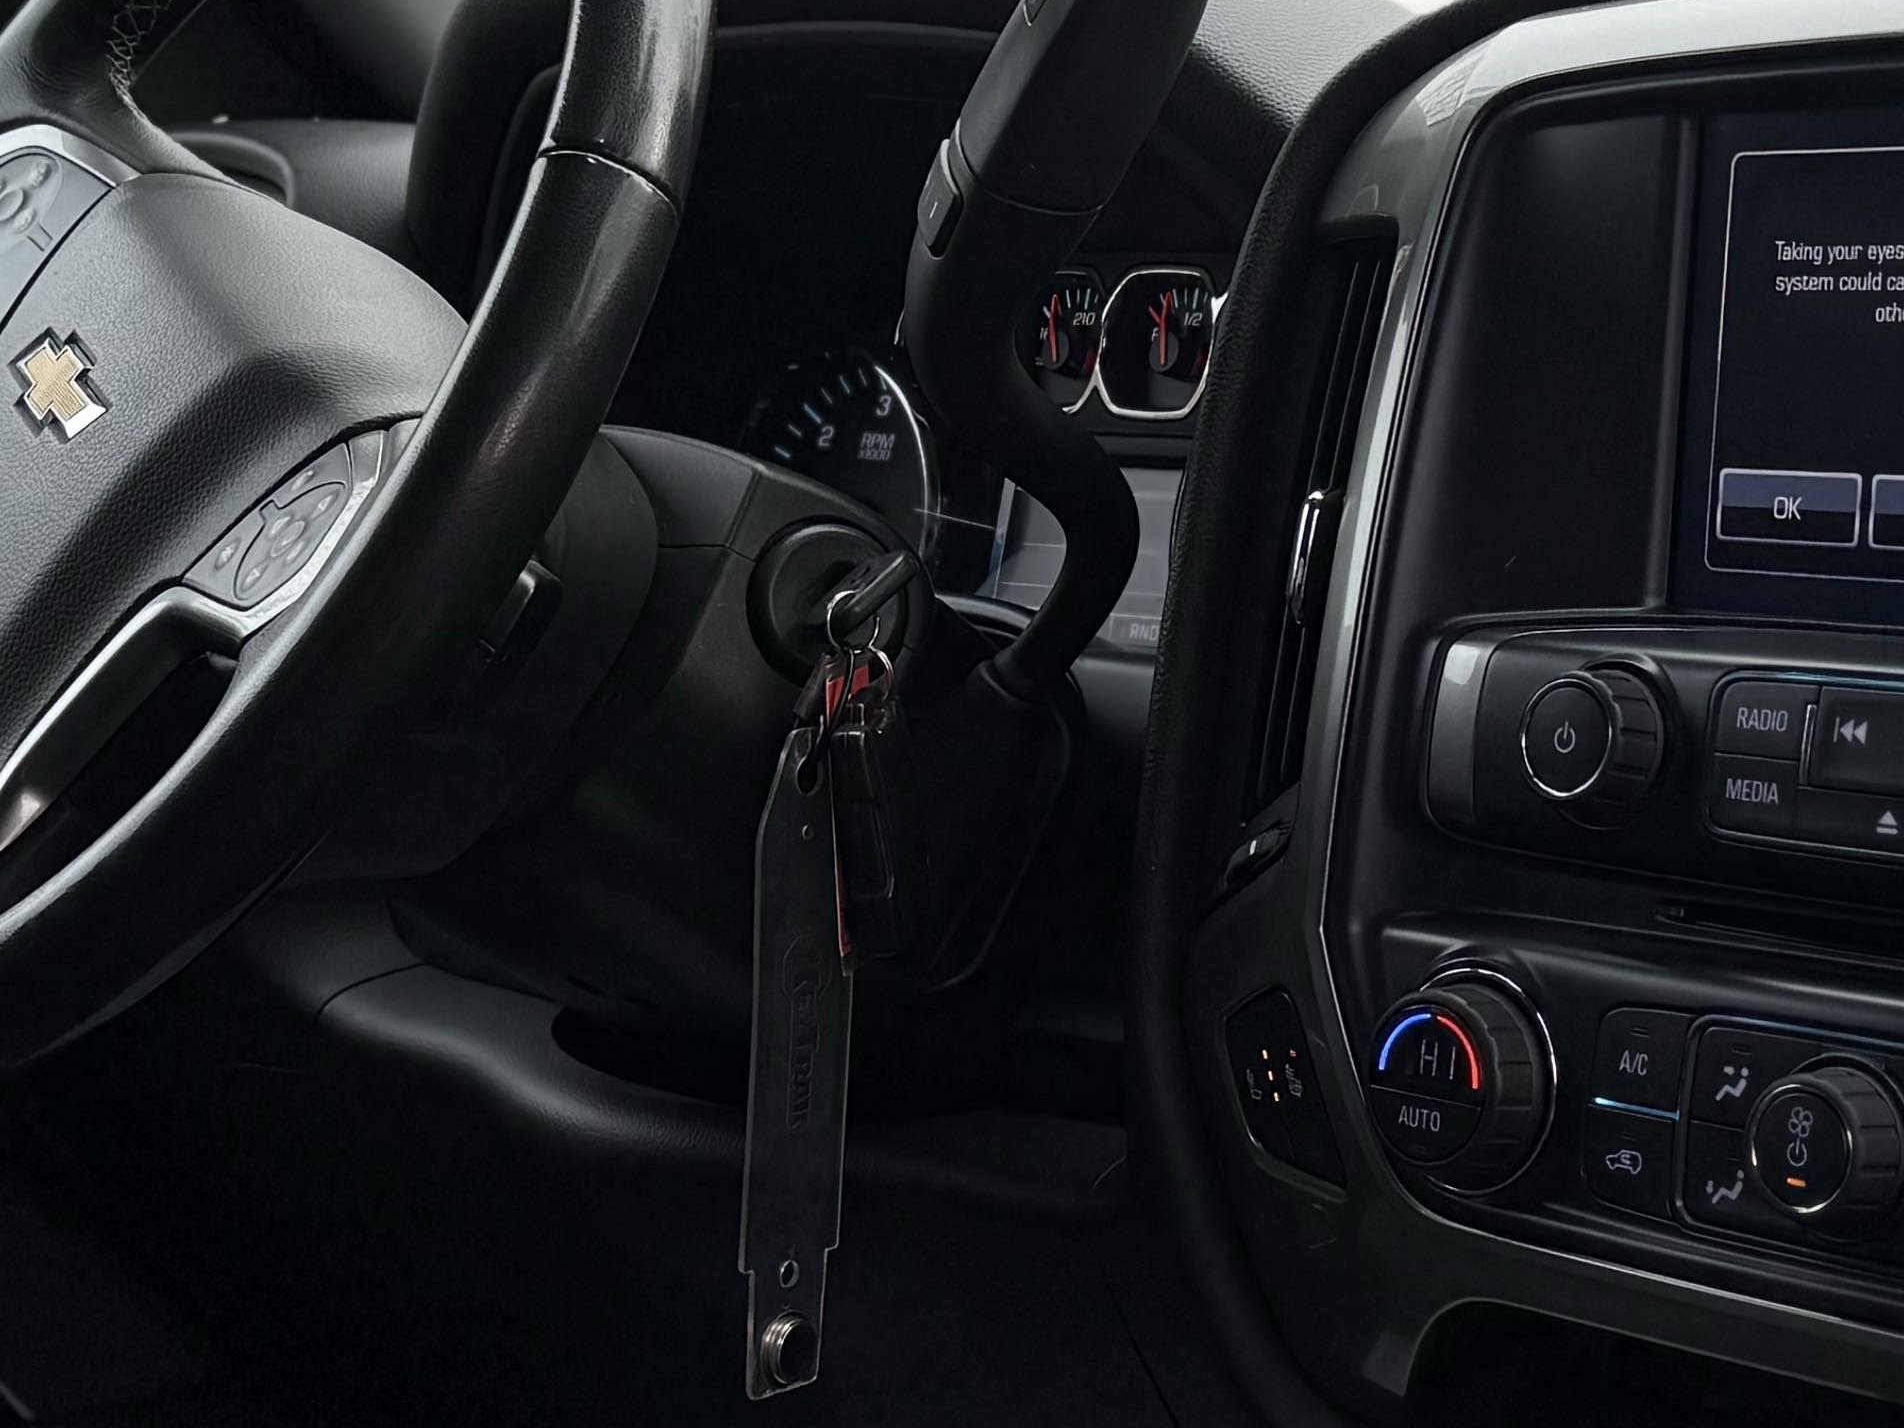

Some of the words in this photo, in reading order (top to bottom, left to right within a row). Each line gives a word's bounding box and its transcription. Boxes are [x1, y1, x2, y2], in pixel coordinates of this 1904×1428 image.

[1776, 241, 1823, 265] Taking
[1828, 246, 1863, 264] your
[1868, 245, 1904, 263] eyes
[1776, 276, 1833, 295] system
[1839, 270, 1882, 291] could
[1073, 312, 1096, 326] 210
[1184, 312, 1203, 326] 1/2
[875, 395, 892, 417] 3
[817, 426, 834, 448] 2
[860, 433, 895, 449] RPM
[1774, 496, 1802, 520] OK
[1737, 707, 1788, 732] RADIO
[1726, 778, 1778, 804] MEDIA
[1619, 1050, 1648, 1075] A/C
[1399, 1107, 1441, 1132] AUTO
